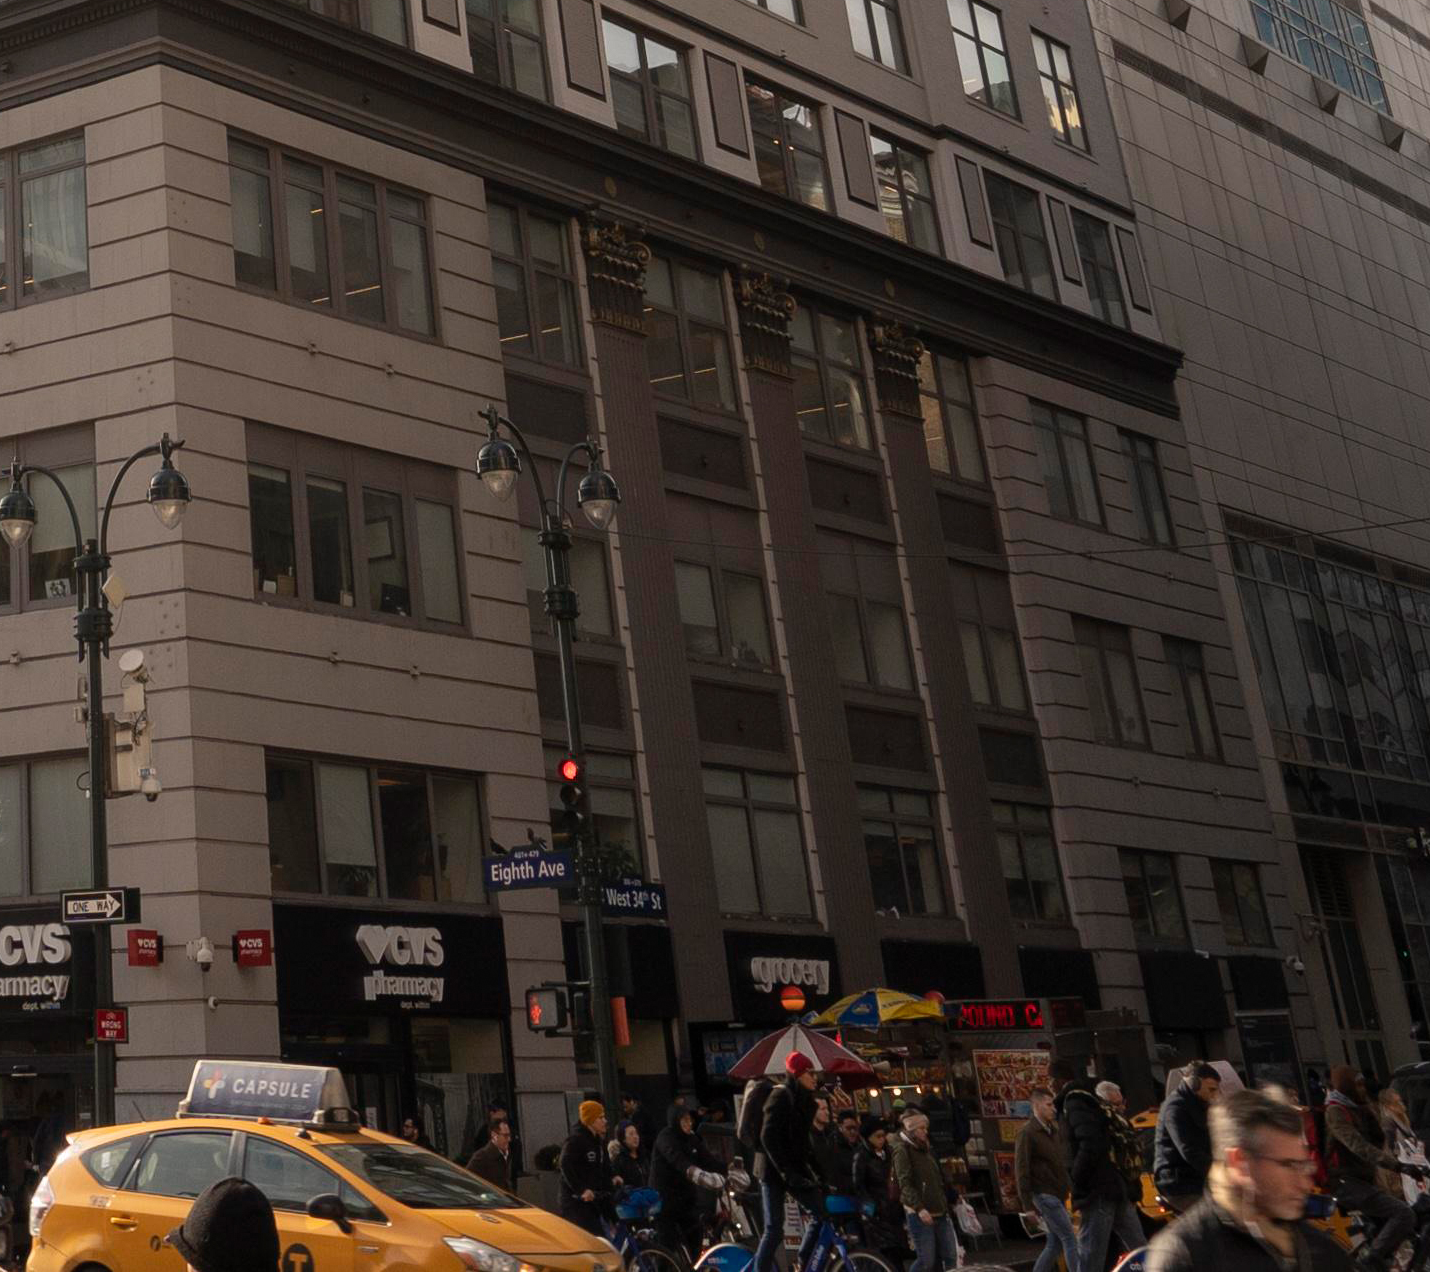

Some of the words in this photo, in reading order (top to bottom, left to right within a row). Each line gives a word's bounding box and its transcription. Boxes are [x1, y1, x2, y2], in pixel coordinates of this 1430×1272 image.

[490, 861, 535, 885] Eighth
[538, 860, 565, 877] Ave
[72, 901, 90, 913] ONE
[96, 899, 115, 912] WAY
[606, 888, 631, 908] West
[632, 889, 649, 908] 34th
[650, 891, 663, 911] St
[143, 939, 157, 948] CVS
[247, 938, 263, 948] CVS
[385, 925, 445, 967] CVS
[363, 969, 445, 1002] pharmacy
[750, 957, 830, 996] grocery
[100, 1020, 121, 1029] WRONG
[105, 1030, 117, 1038] WAY
[232, 1078, 313, 1099] CAPSULE
